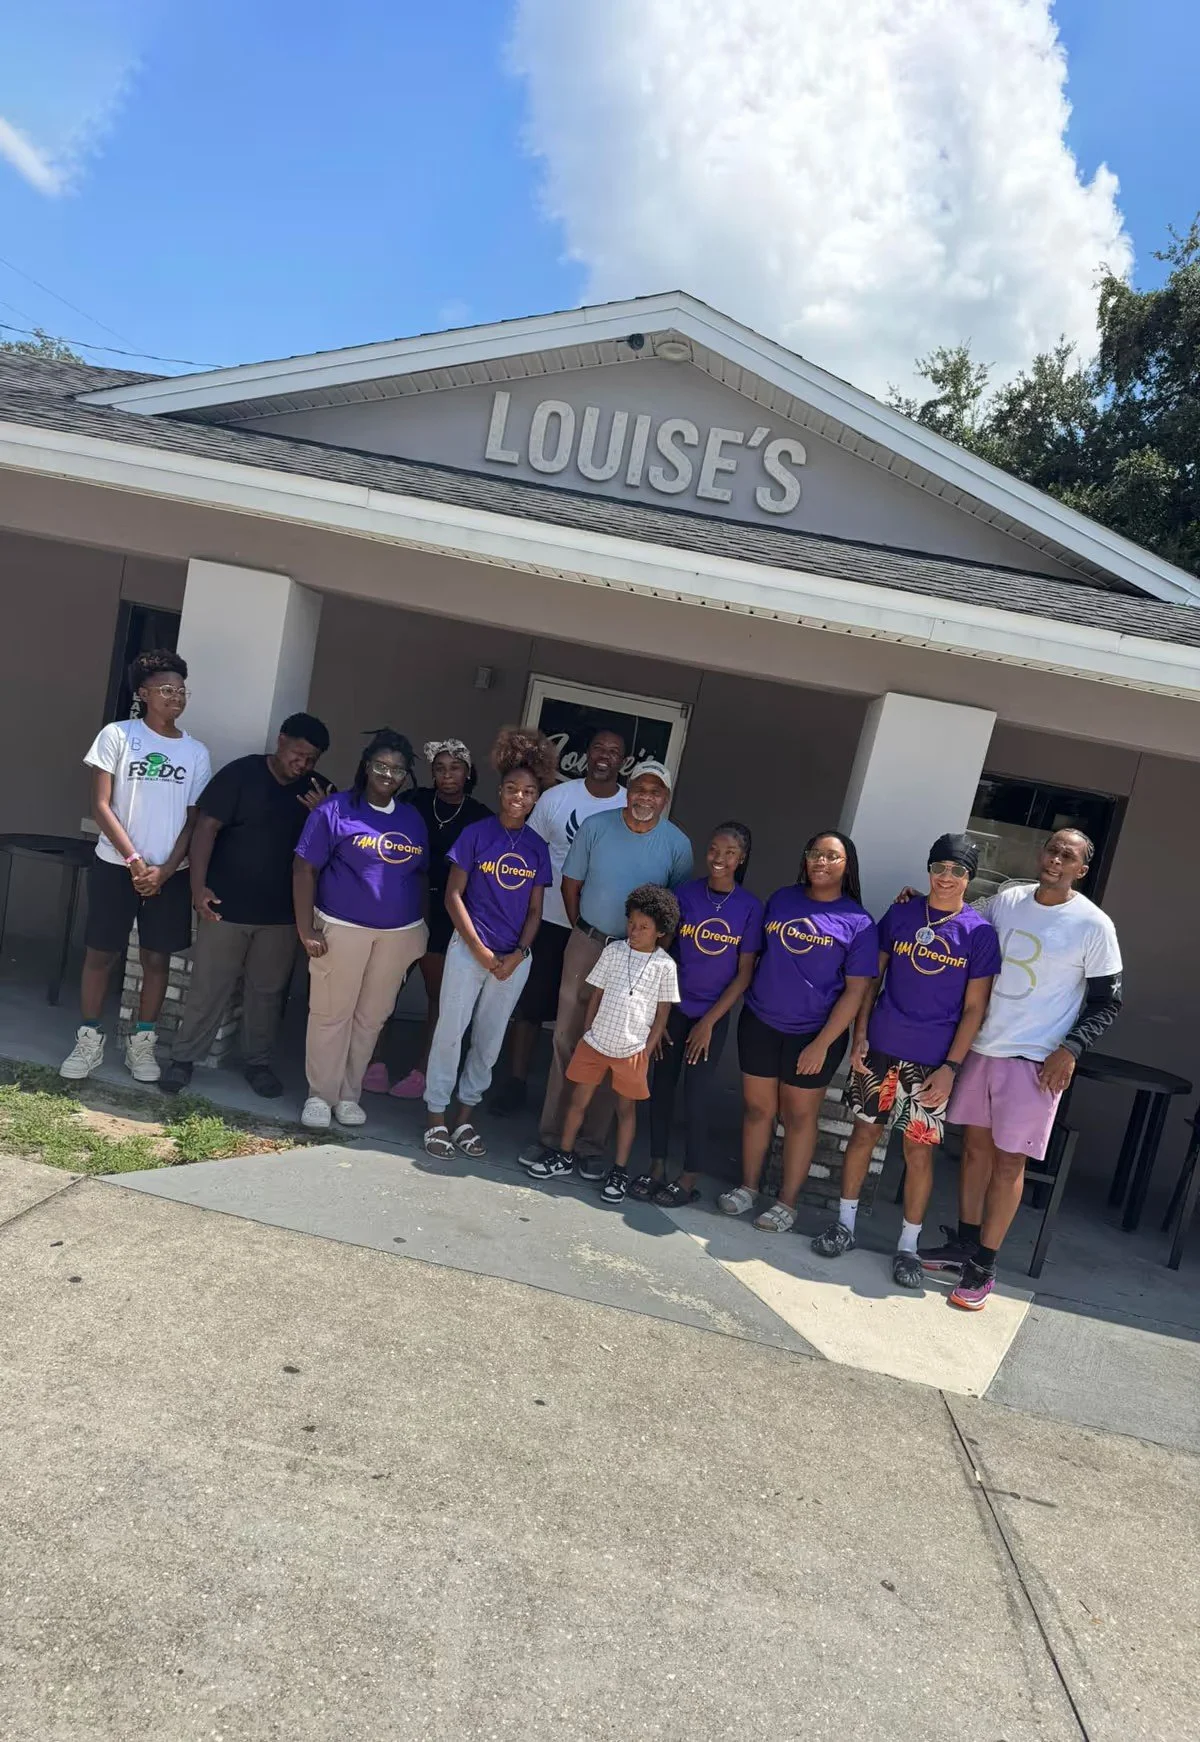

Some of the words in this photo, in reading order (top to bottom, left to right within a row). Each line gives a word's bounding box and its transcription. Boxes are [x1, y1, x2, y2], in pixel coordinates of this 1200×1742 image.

[484, 390, 807, 514] LOUISE'S
[358, 835, 377, 850] AM
[896, 941, 913, 956] AM
[917, 946, 968, 968] DreamFi
